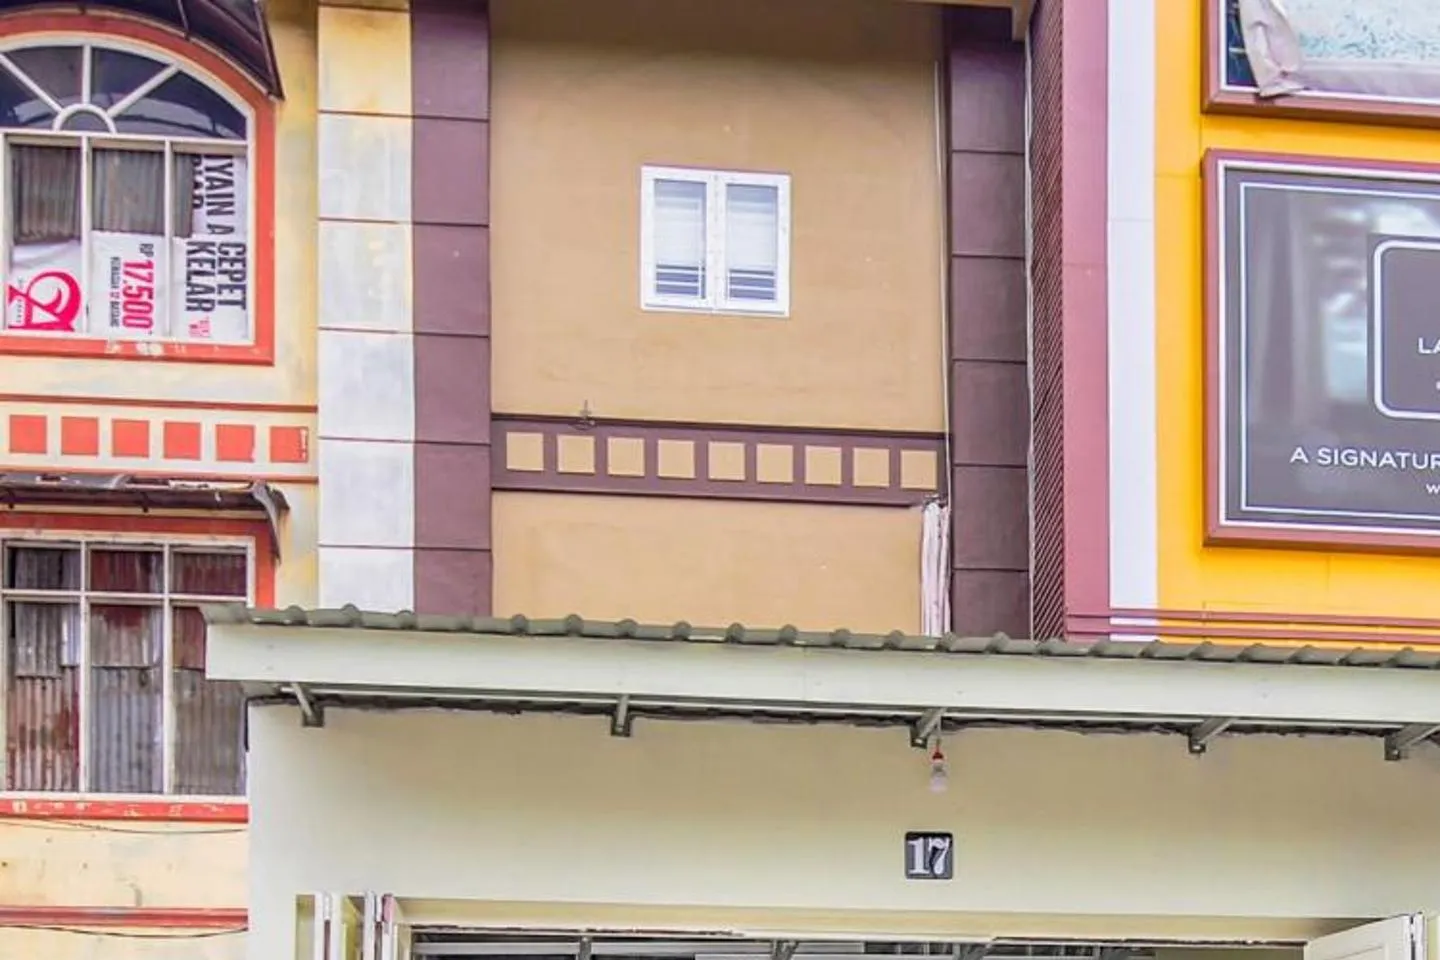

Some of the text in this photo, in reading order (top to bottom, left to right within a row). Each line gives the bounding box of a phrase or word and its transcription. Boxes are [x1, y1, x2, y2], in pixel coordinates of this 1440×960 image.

[185, 240, 216, 312] KELAR
[217, 241, 247, 311] CEPET
[1289, 446, 1309, 464] A
[907, 836, 950, 875] 17
